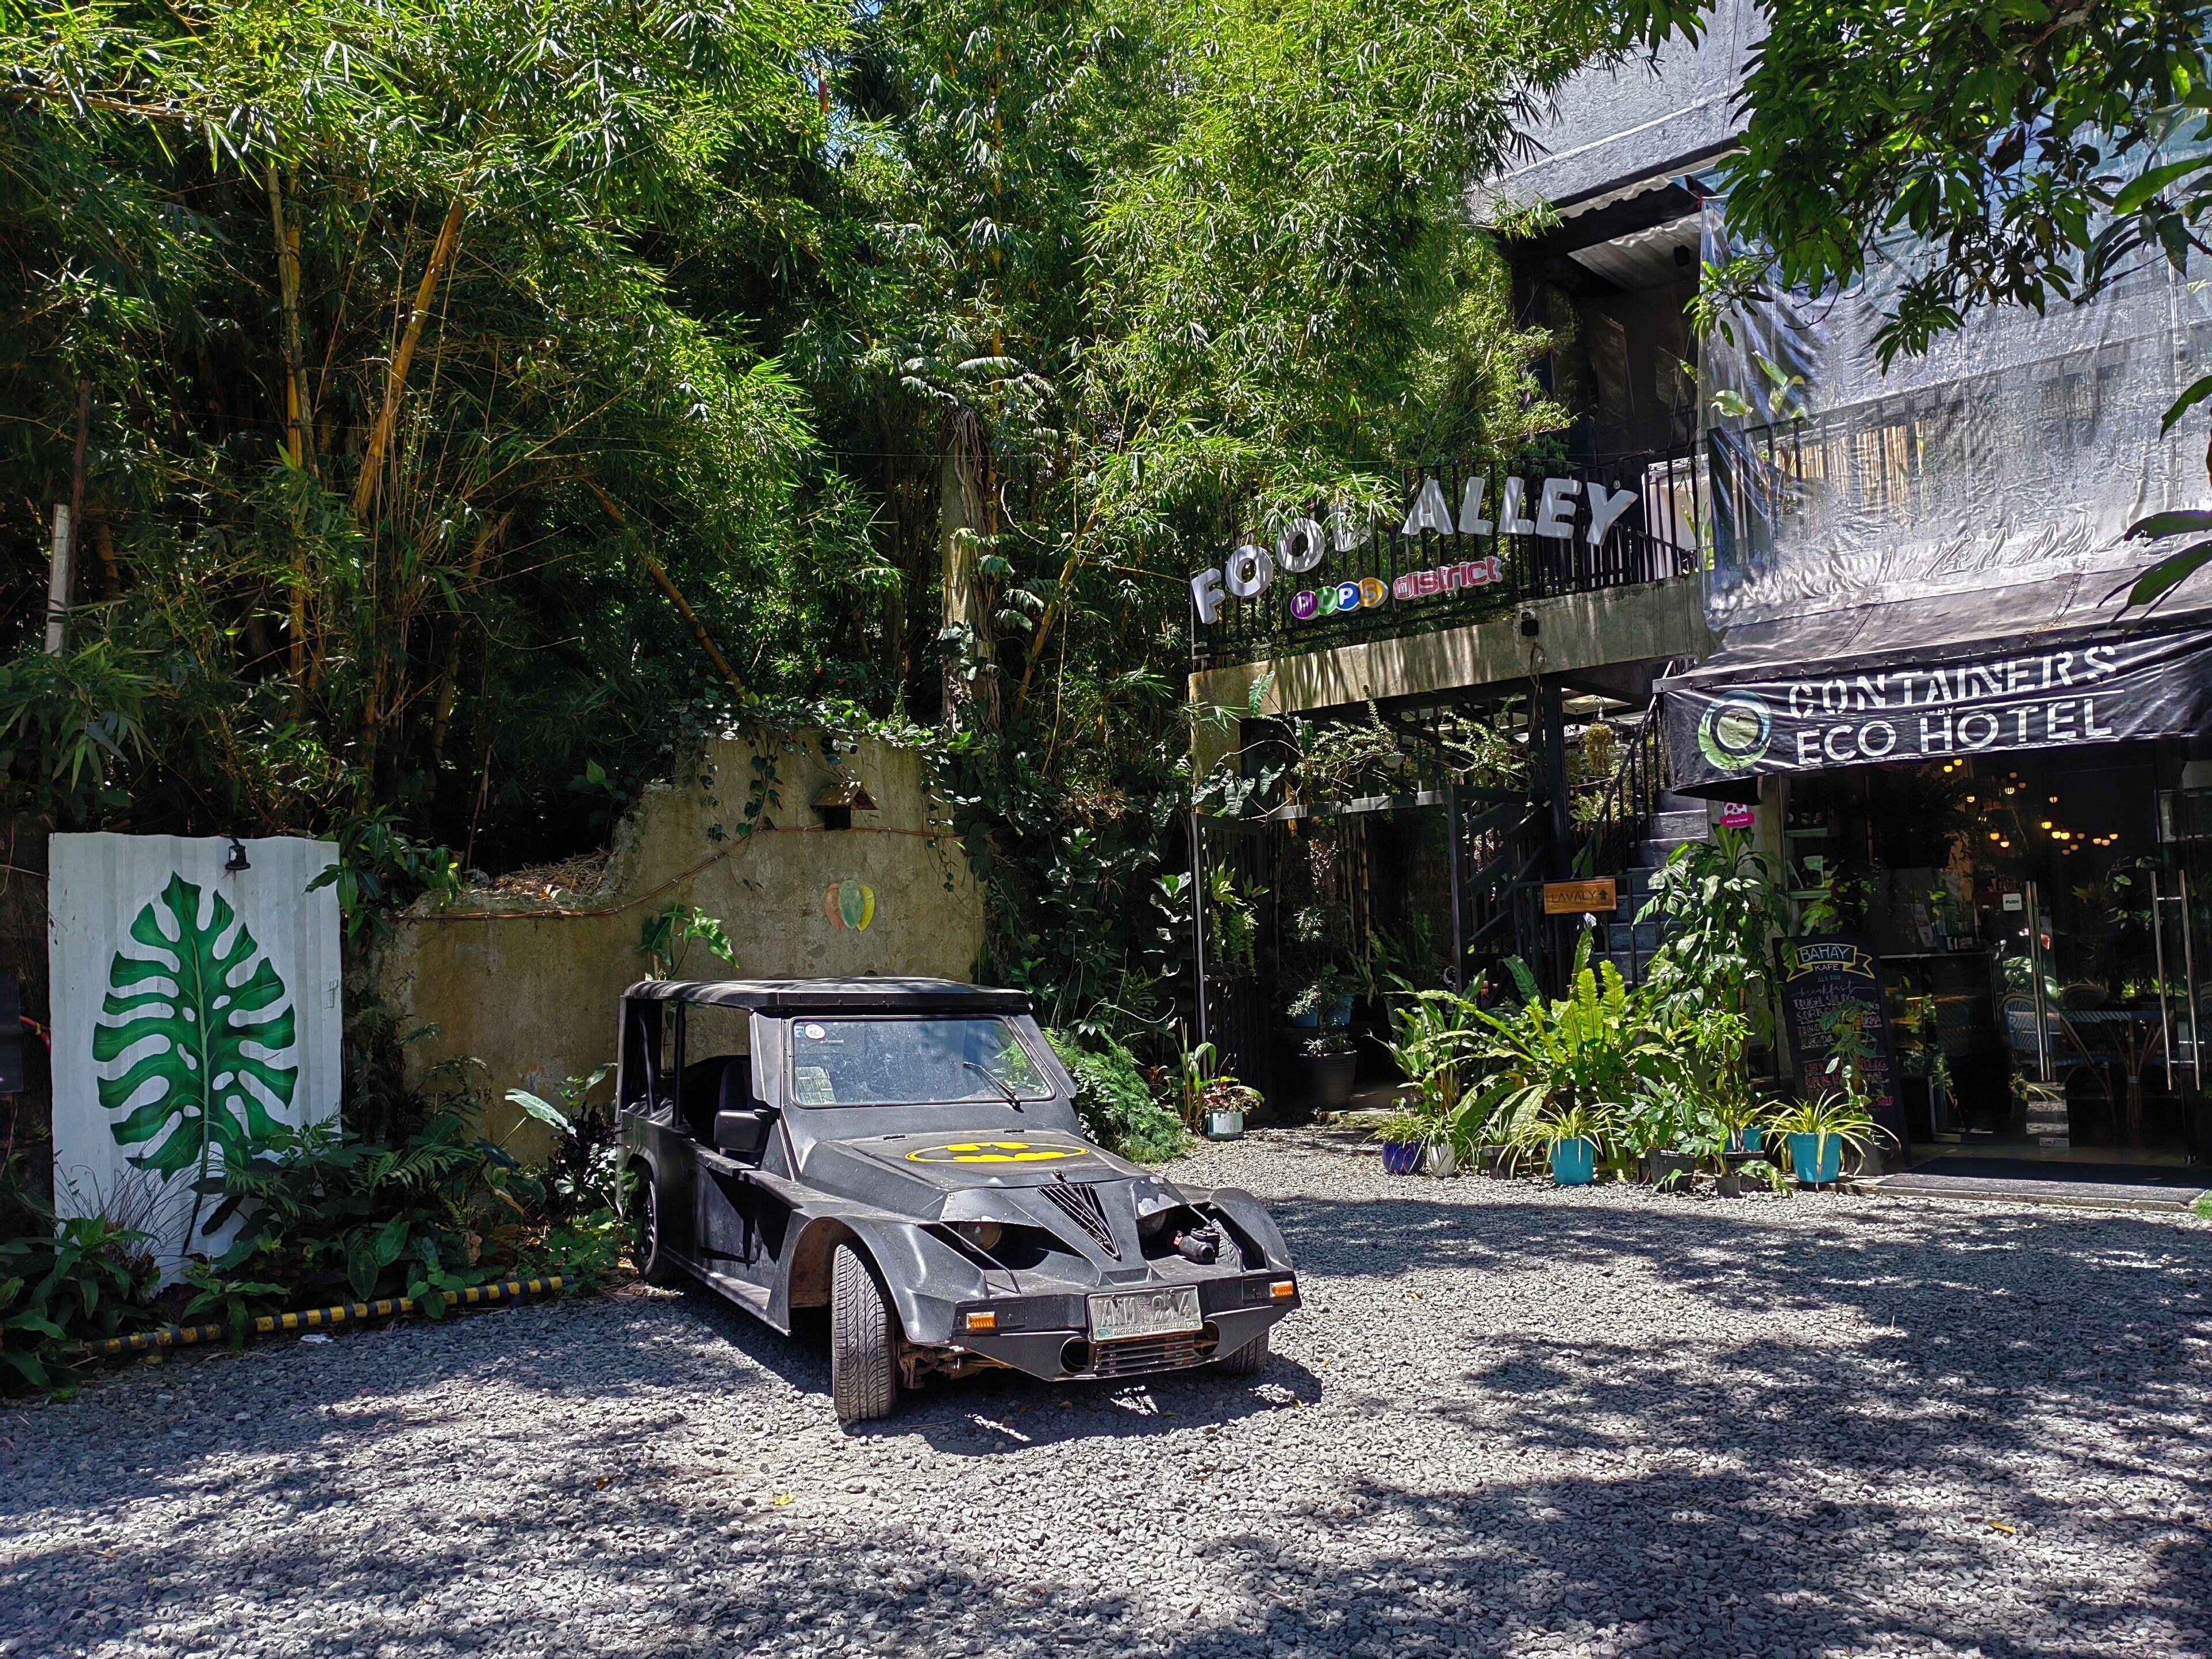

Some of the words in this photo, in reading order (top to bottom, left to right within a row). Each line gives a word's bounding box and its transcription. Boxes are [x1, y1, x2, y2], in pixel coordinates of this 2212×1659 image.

[1402, 476, 1638, 547] ALLEY
[1393, 556, 1499, 600] district
[1789, 646, 2116, 718] CONTAINERS
[1937, 706, 1955, 715] BY
[1797, 721, 1896, 765] ECO
[1920, 699, 2112, 753] HOTEL
[1552, 890, 1596, 903] LAVALY
[1800, 946, 1850, 963] BAHAY
[1814, 964, 1841, 972] KAFE
